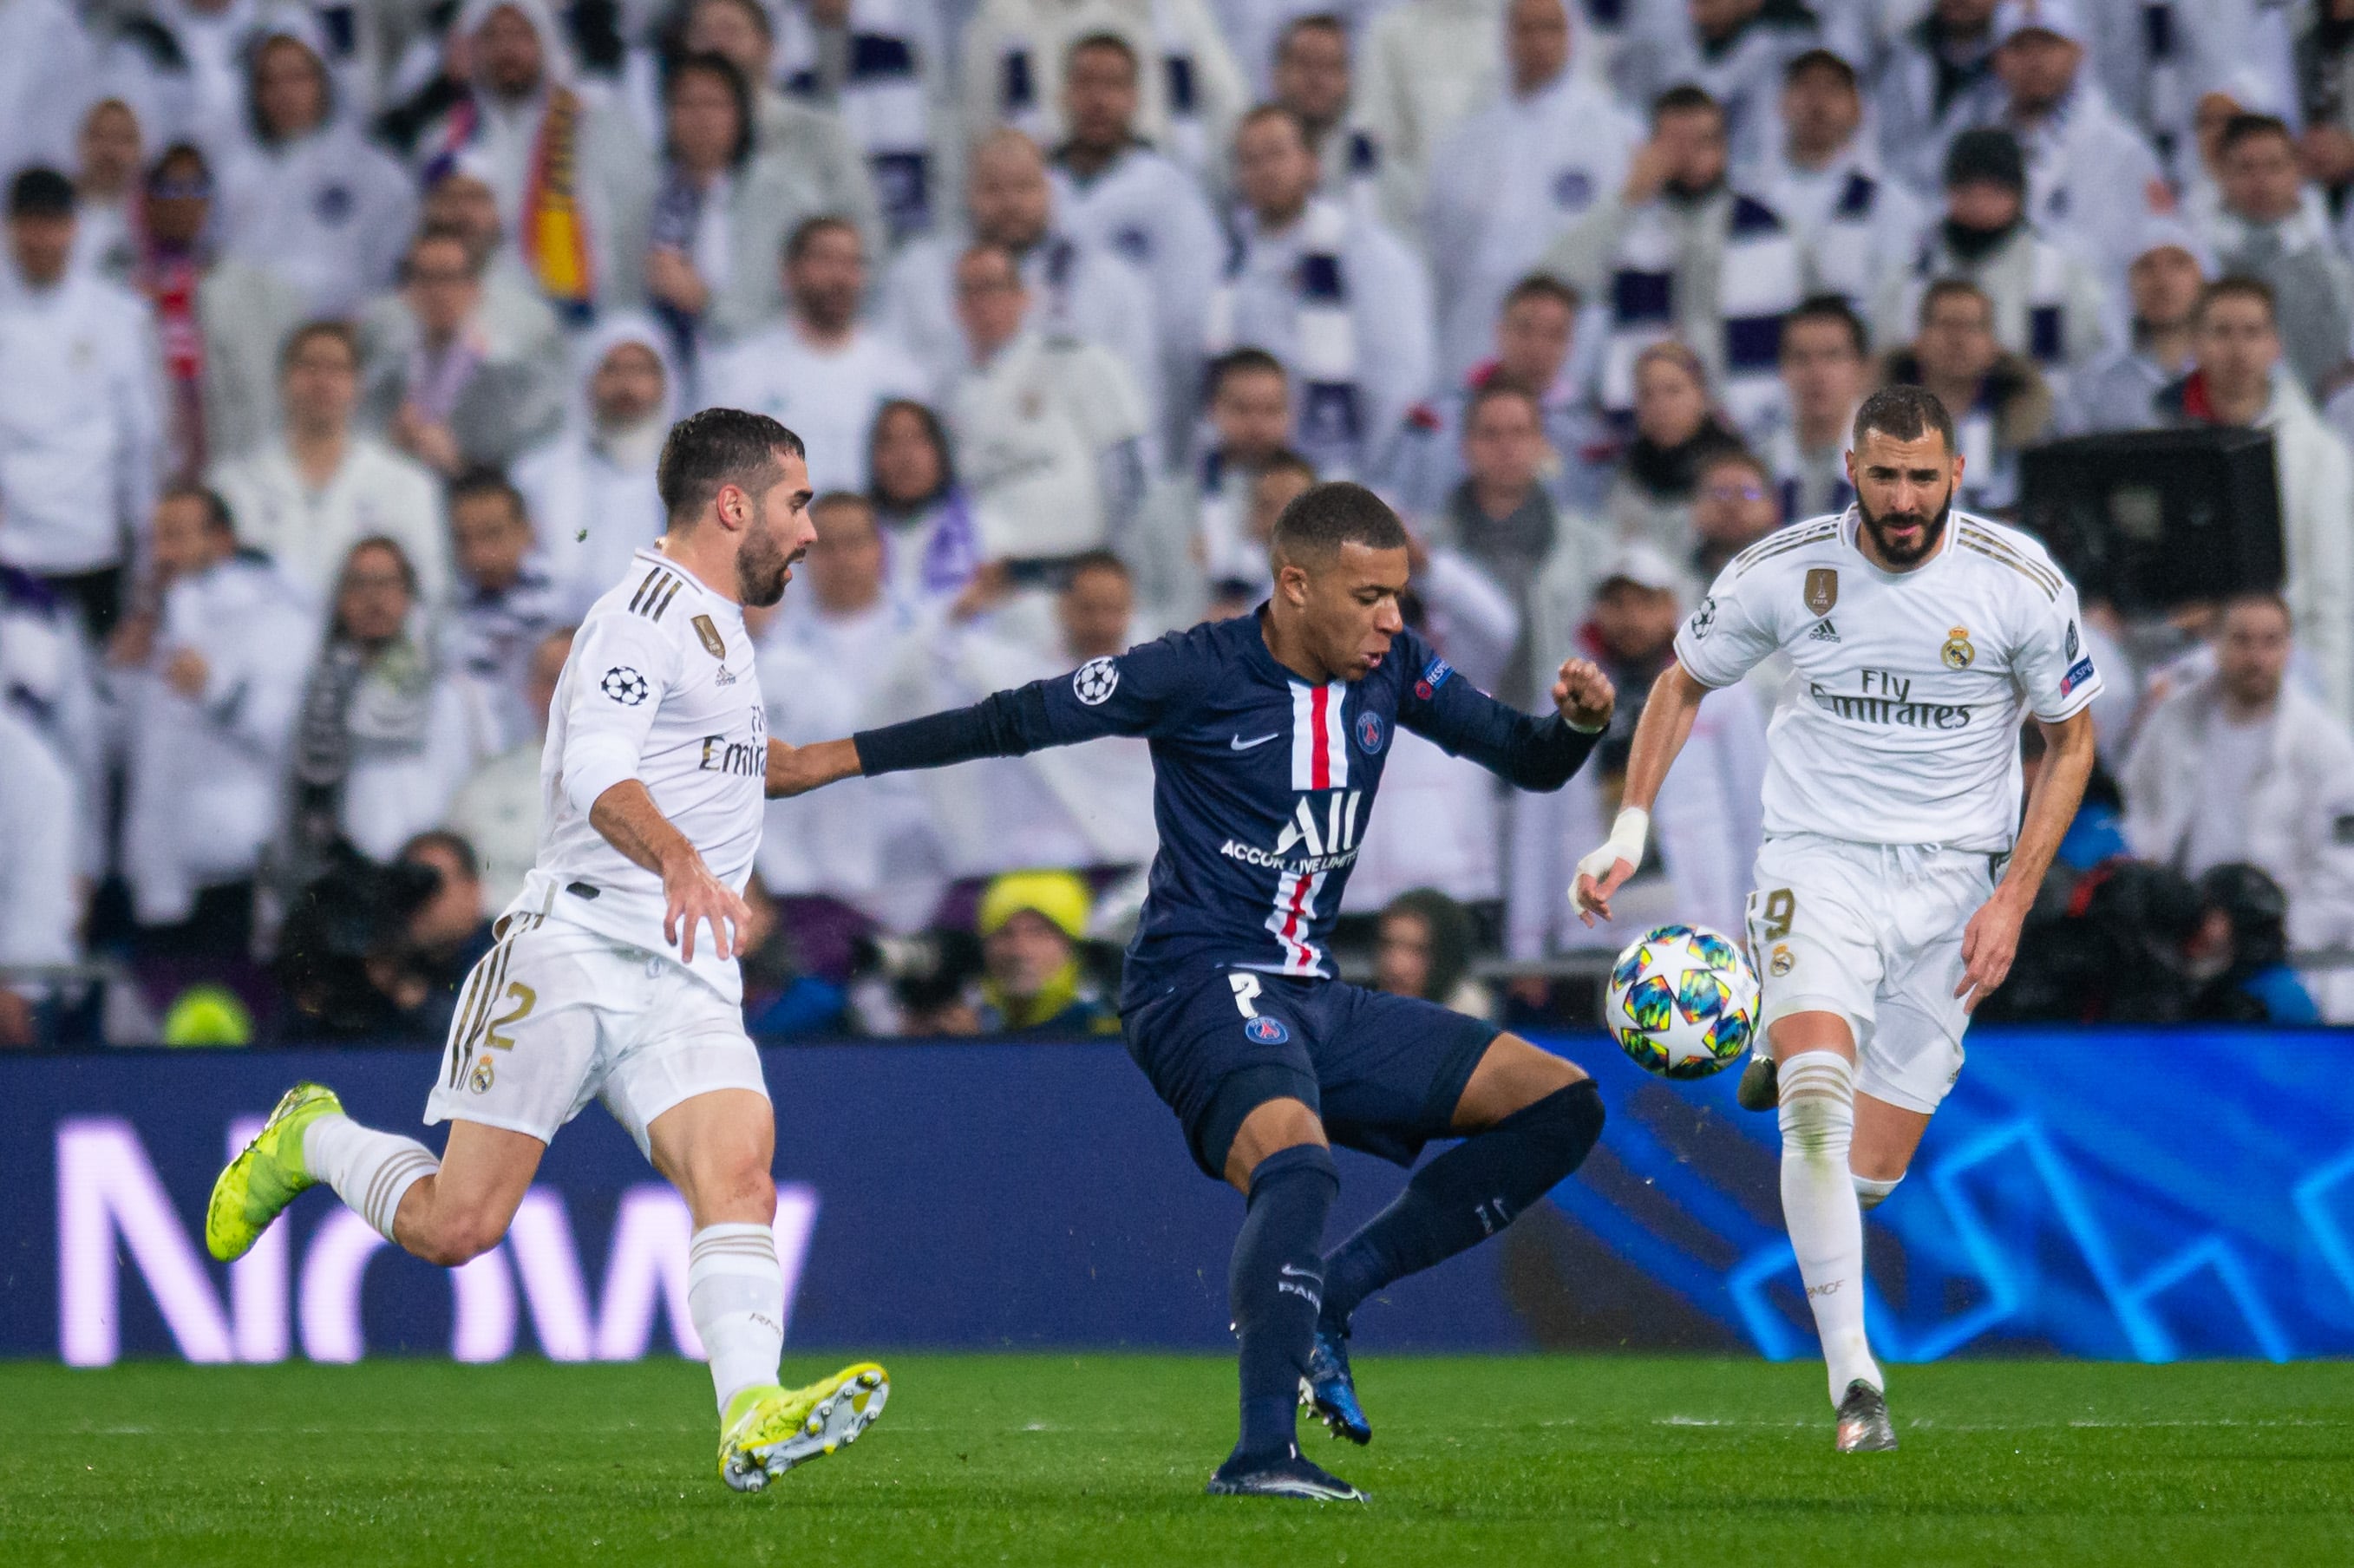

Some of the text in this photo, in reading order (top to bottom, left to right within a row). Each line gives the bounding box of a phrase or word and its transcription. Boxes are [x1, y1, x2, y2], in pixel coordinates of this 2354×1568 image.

[1808, 632, 1841, 644] adidas
[1861, 669, 1911, 703] Fly
[750, 705, 767, 733] Fl
[1764, 887, 1795, 944] 9
[483, 981, 537, 1051] 2
